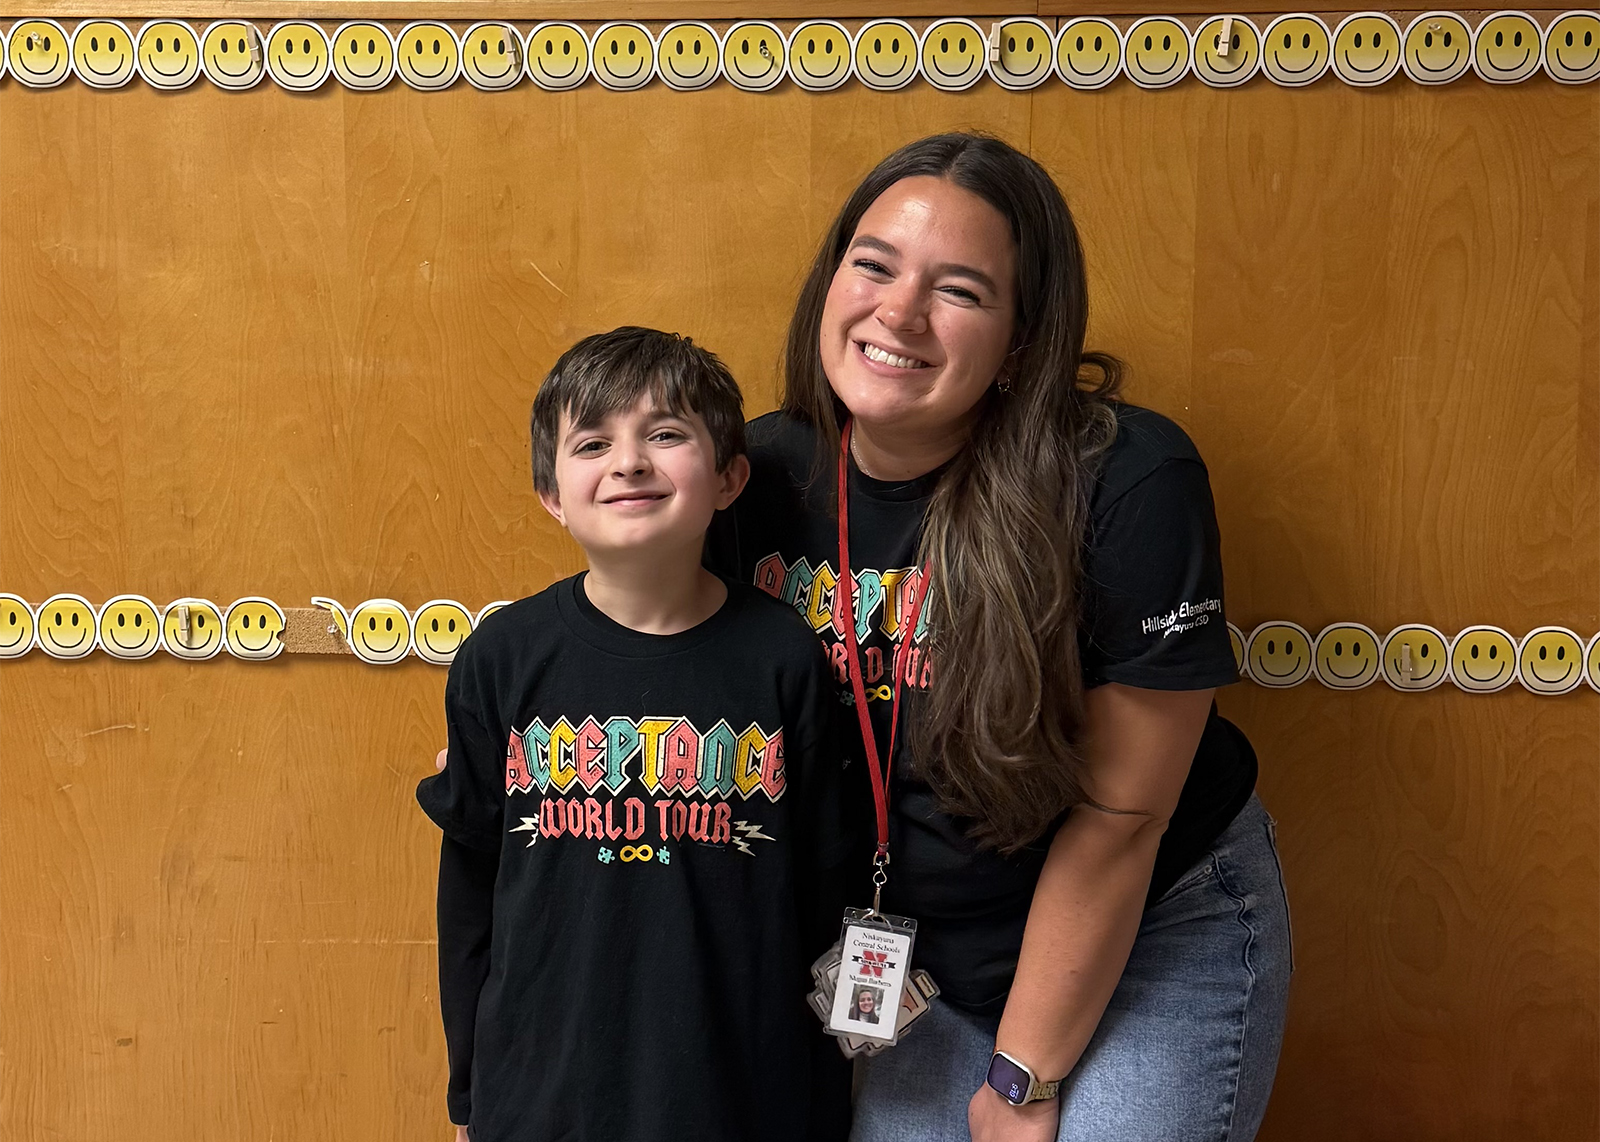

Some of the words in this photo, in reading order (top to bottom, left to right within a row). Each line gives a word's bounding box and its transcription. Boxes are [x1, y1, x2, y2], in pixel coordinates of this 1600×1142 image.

[1142, 609, 1178, 635] Hillsid
[1194, 614, 1209, 627] CSD
[505, 714, 788, 803] ACCEPTANCE
[538, 797, 646, 841] WORLD
[654, 799, 732, 844] TOUR
[852, 939, 876, 950] Central
[876, 943, 901, 954] Schools
